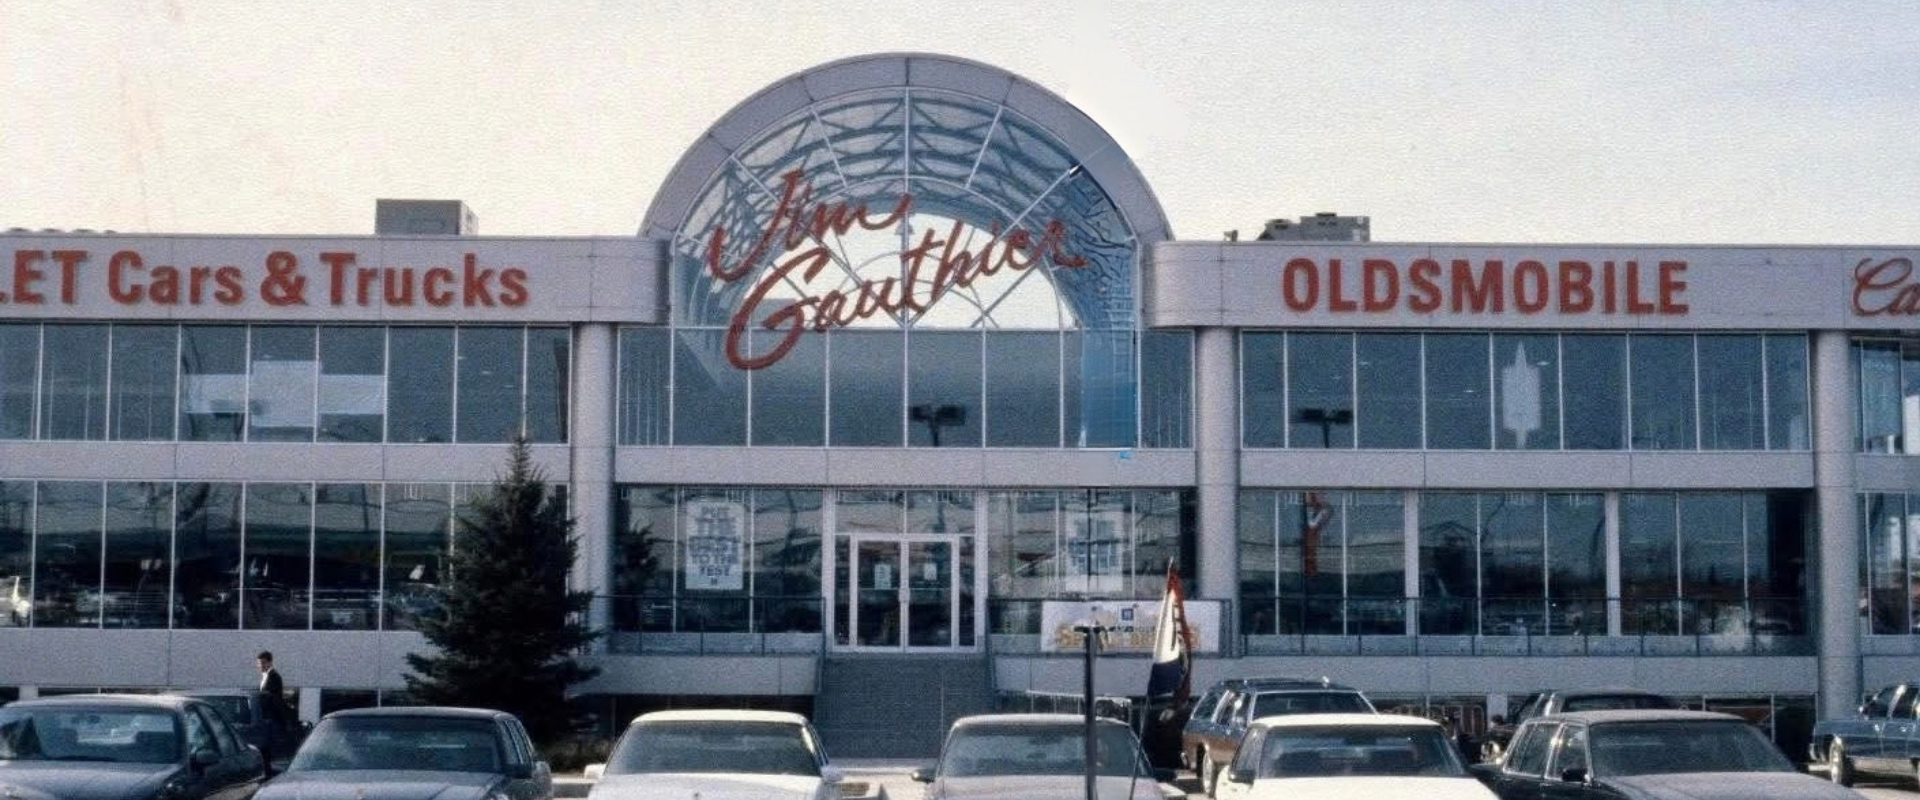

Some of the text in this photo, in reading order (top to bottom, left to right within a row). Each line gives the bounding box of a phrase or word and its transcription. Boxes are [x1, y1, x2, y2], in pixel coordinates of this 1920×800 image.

[707, 168, 911, 283] Jim
[0, 249, 529, 308] ET Cars & Trucks
[725, 220, 1089, 370] Gauthier
[1281, 258, 1689, 315] OLDSMOBILE
